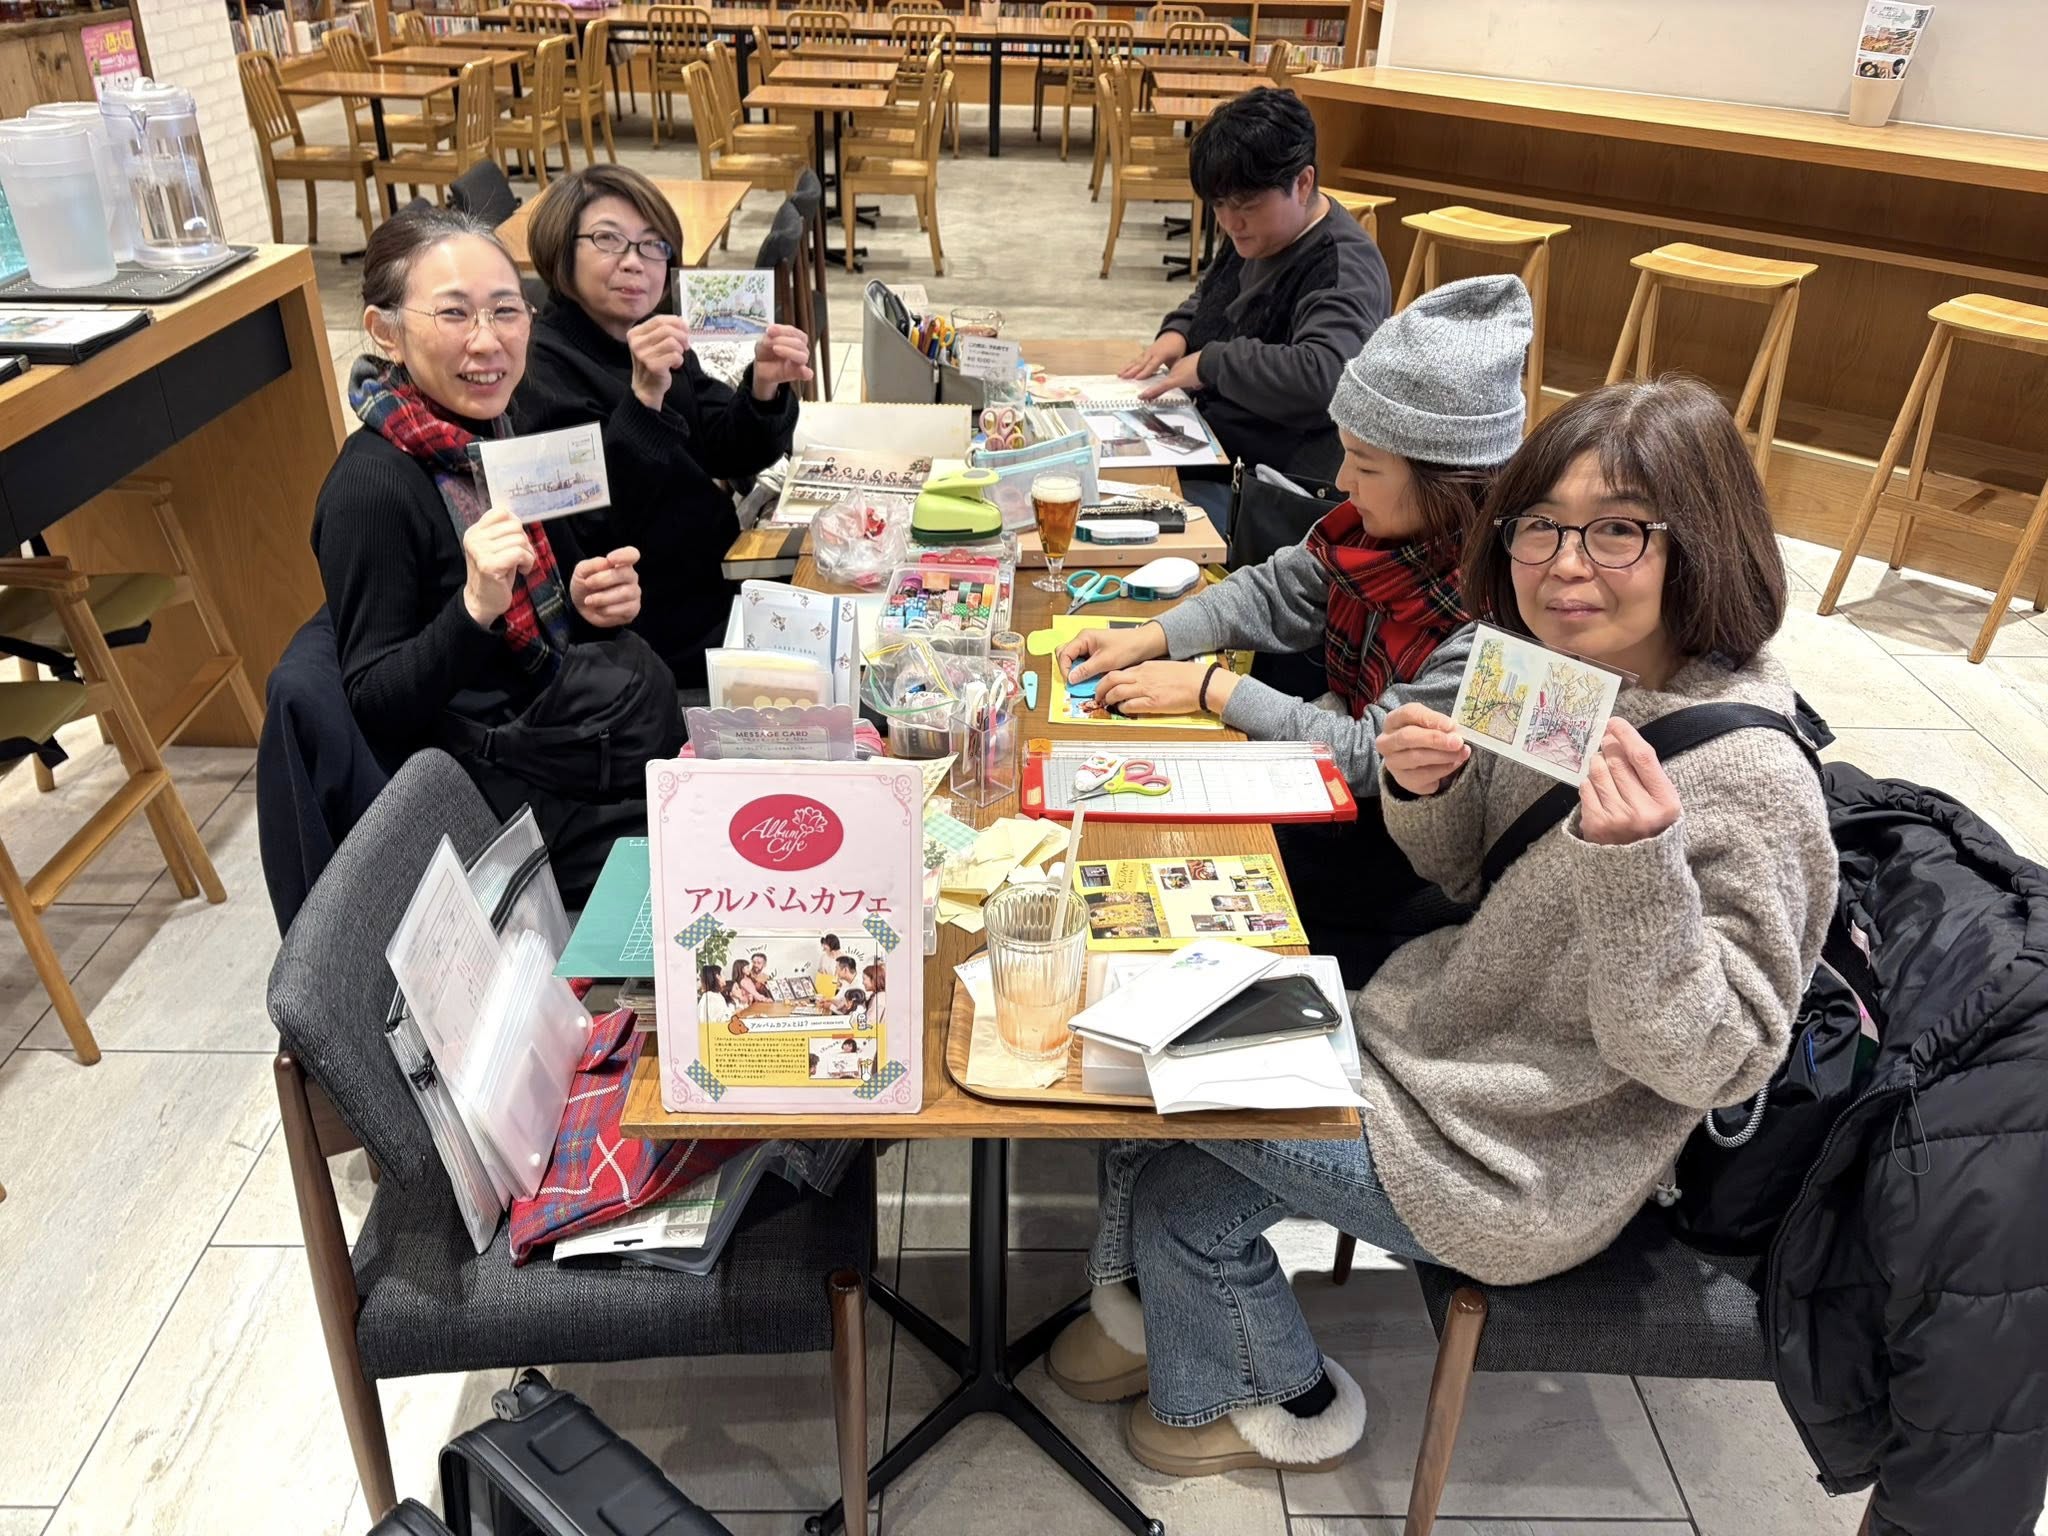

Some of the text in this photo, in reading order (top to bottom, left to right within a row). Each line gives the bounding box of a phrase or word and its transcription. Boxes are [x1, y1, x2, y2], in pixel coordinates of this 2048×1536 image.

[742, 817, 801, 841] Album
[684, 886, 892, 915] アルバムカフェ
